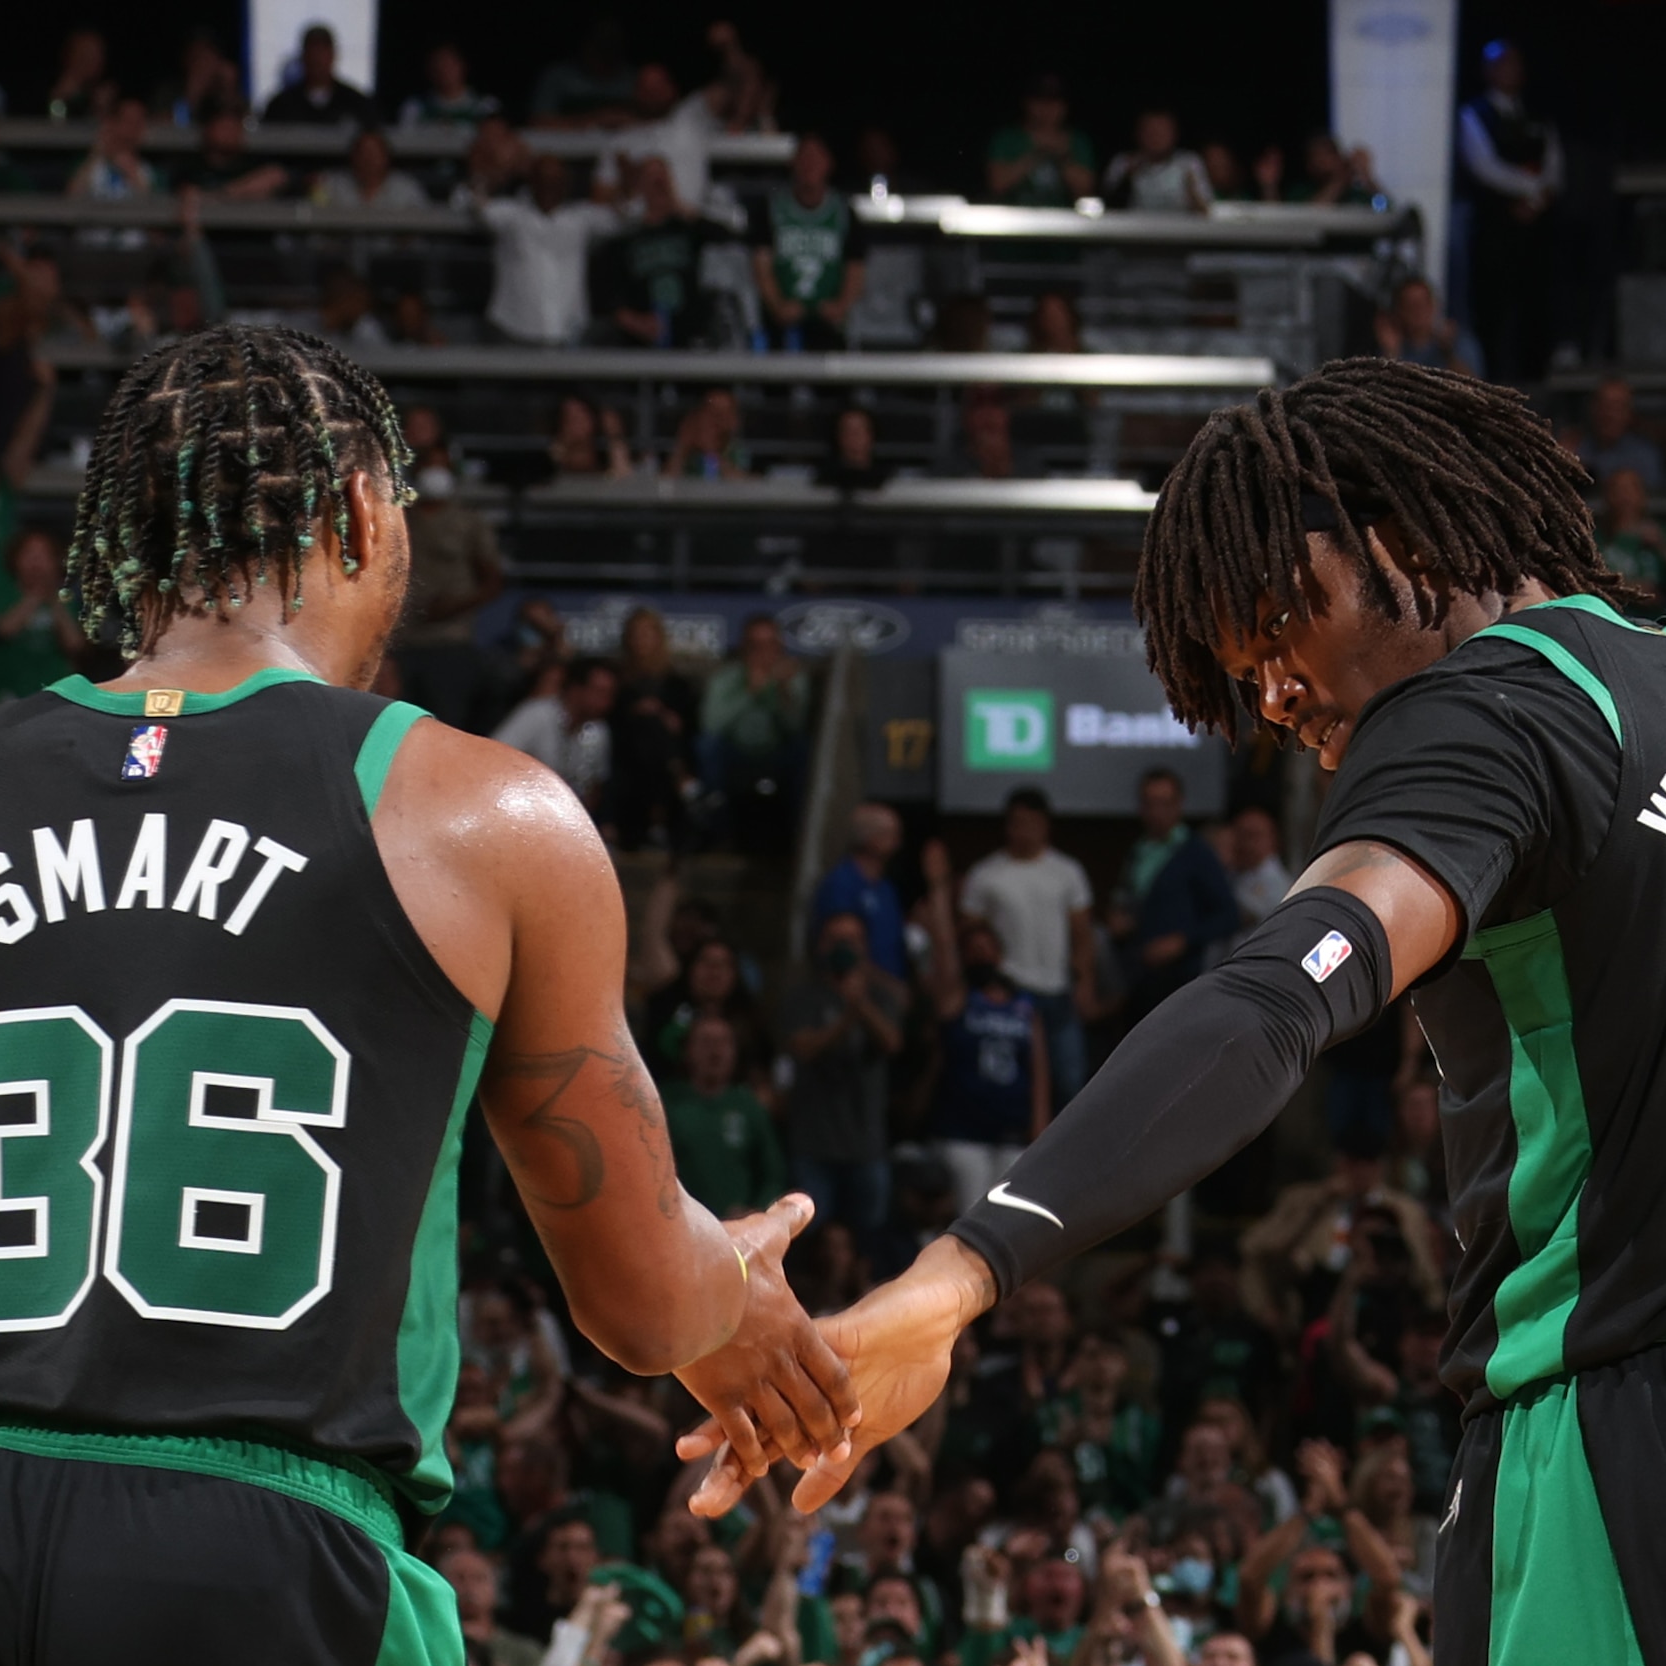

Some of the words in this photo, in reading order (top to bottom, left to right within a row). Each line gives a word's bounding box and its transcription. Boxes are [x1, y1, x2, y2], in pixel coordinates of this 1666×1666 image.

[883, 716, 931, 769] 17
[971, 701, 1047, 756] TD
[1064, 702, 1201, 748] Bank
